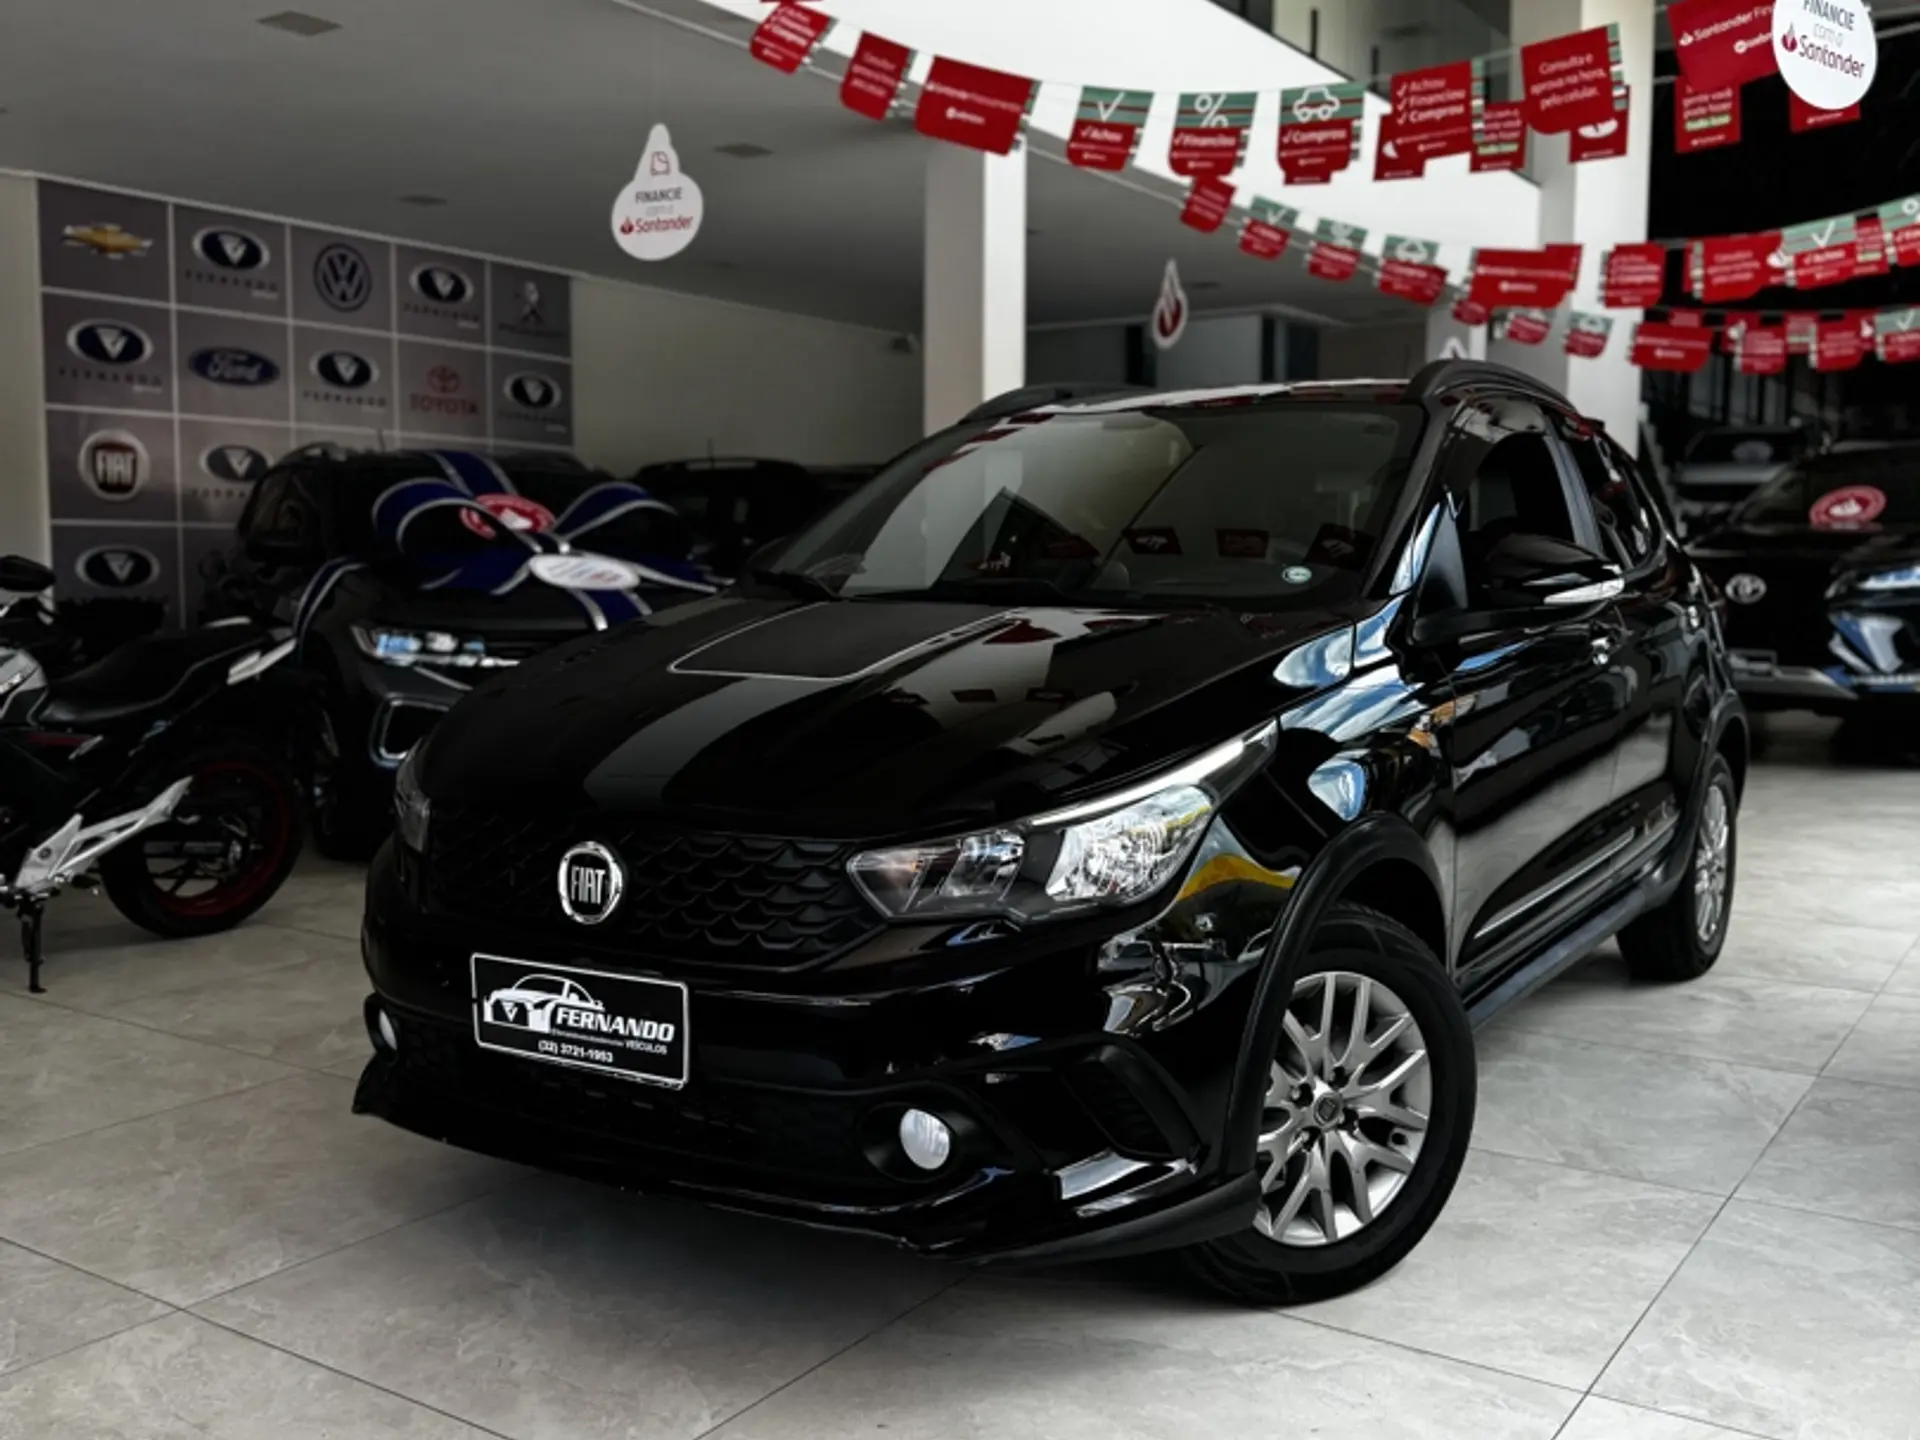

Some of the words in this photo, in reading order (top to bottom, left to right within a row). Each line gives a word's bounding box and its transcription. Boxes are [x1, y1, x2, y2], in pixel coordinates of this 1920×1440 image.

[1693, 11, 1753, 41] Santander
[1798, 34, 1866, 79] Santander
[635, 215, 694, 233] Santander
[409, 392, 480, 416] TOYOTA
[95, 450, 136, 485] FIAT
[570, 865, 606, 905] FIAT
[555, 1006, 676, 1043] FERNANDO
